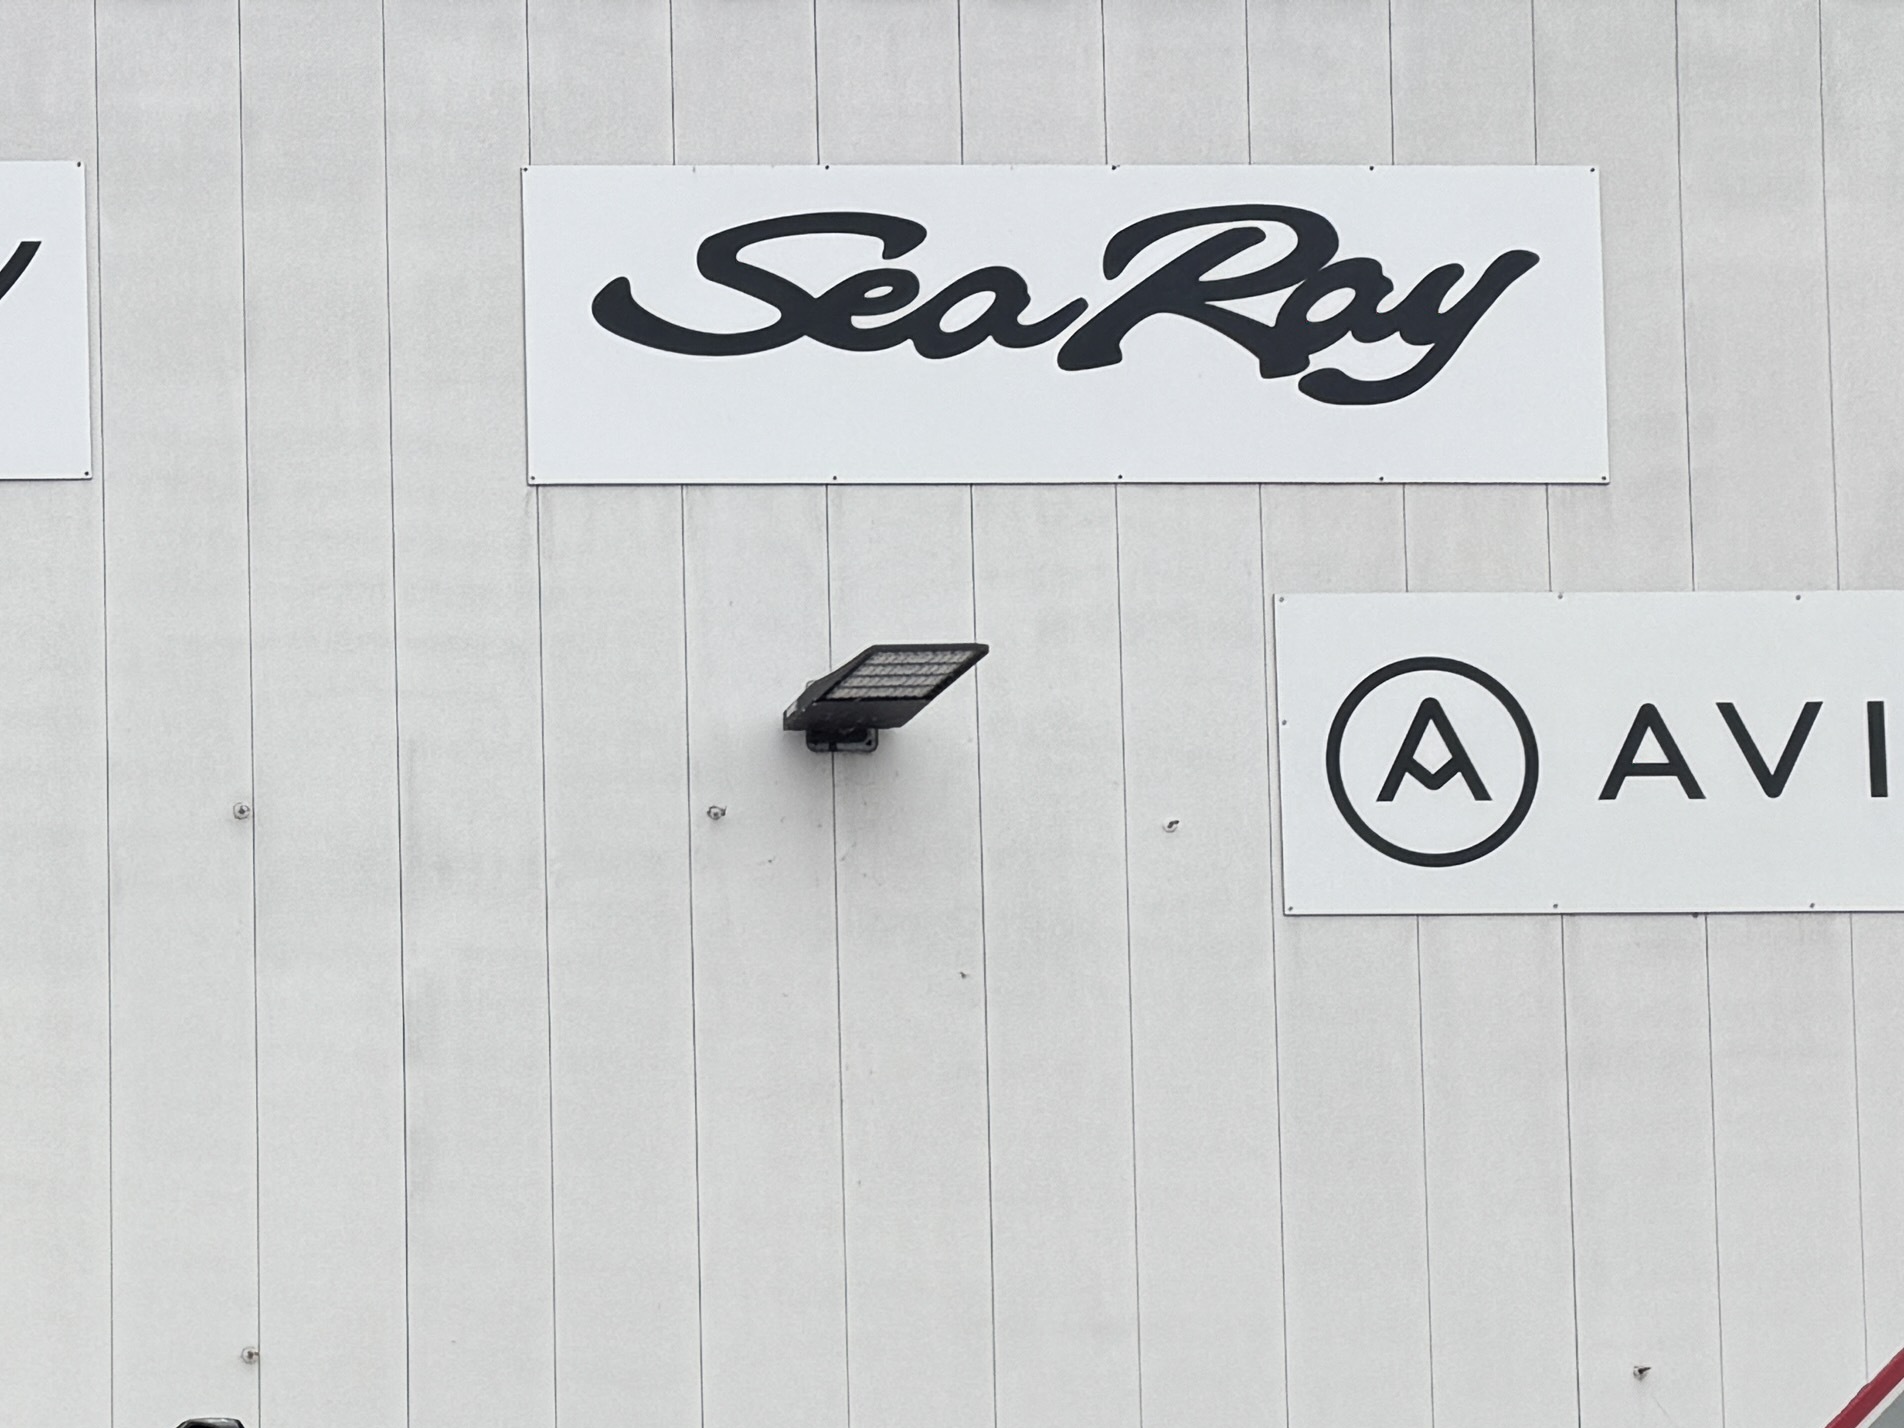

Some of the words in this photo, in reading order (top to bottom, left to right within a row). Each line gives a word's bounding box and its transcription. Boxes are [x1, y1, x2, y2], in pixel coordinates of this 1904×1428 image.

[591, 211, 1089, 360] Sea
[1056, 203, 1540, 406] Ray
[1598, 700, 1889, 801] AVI
